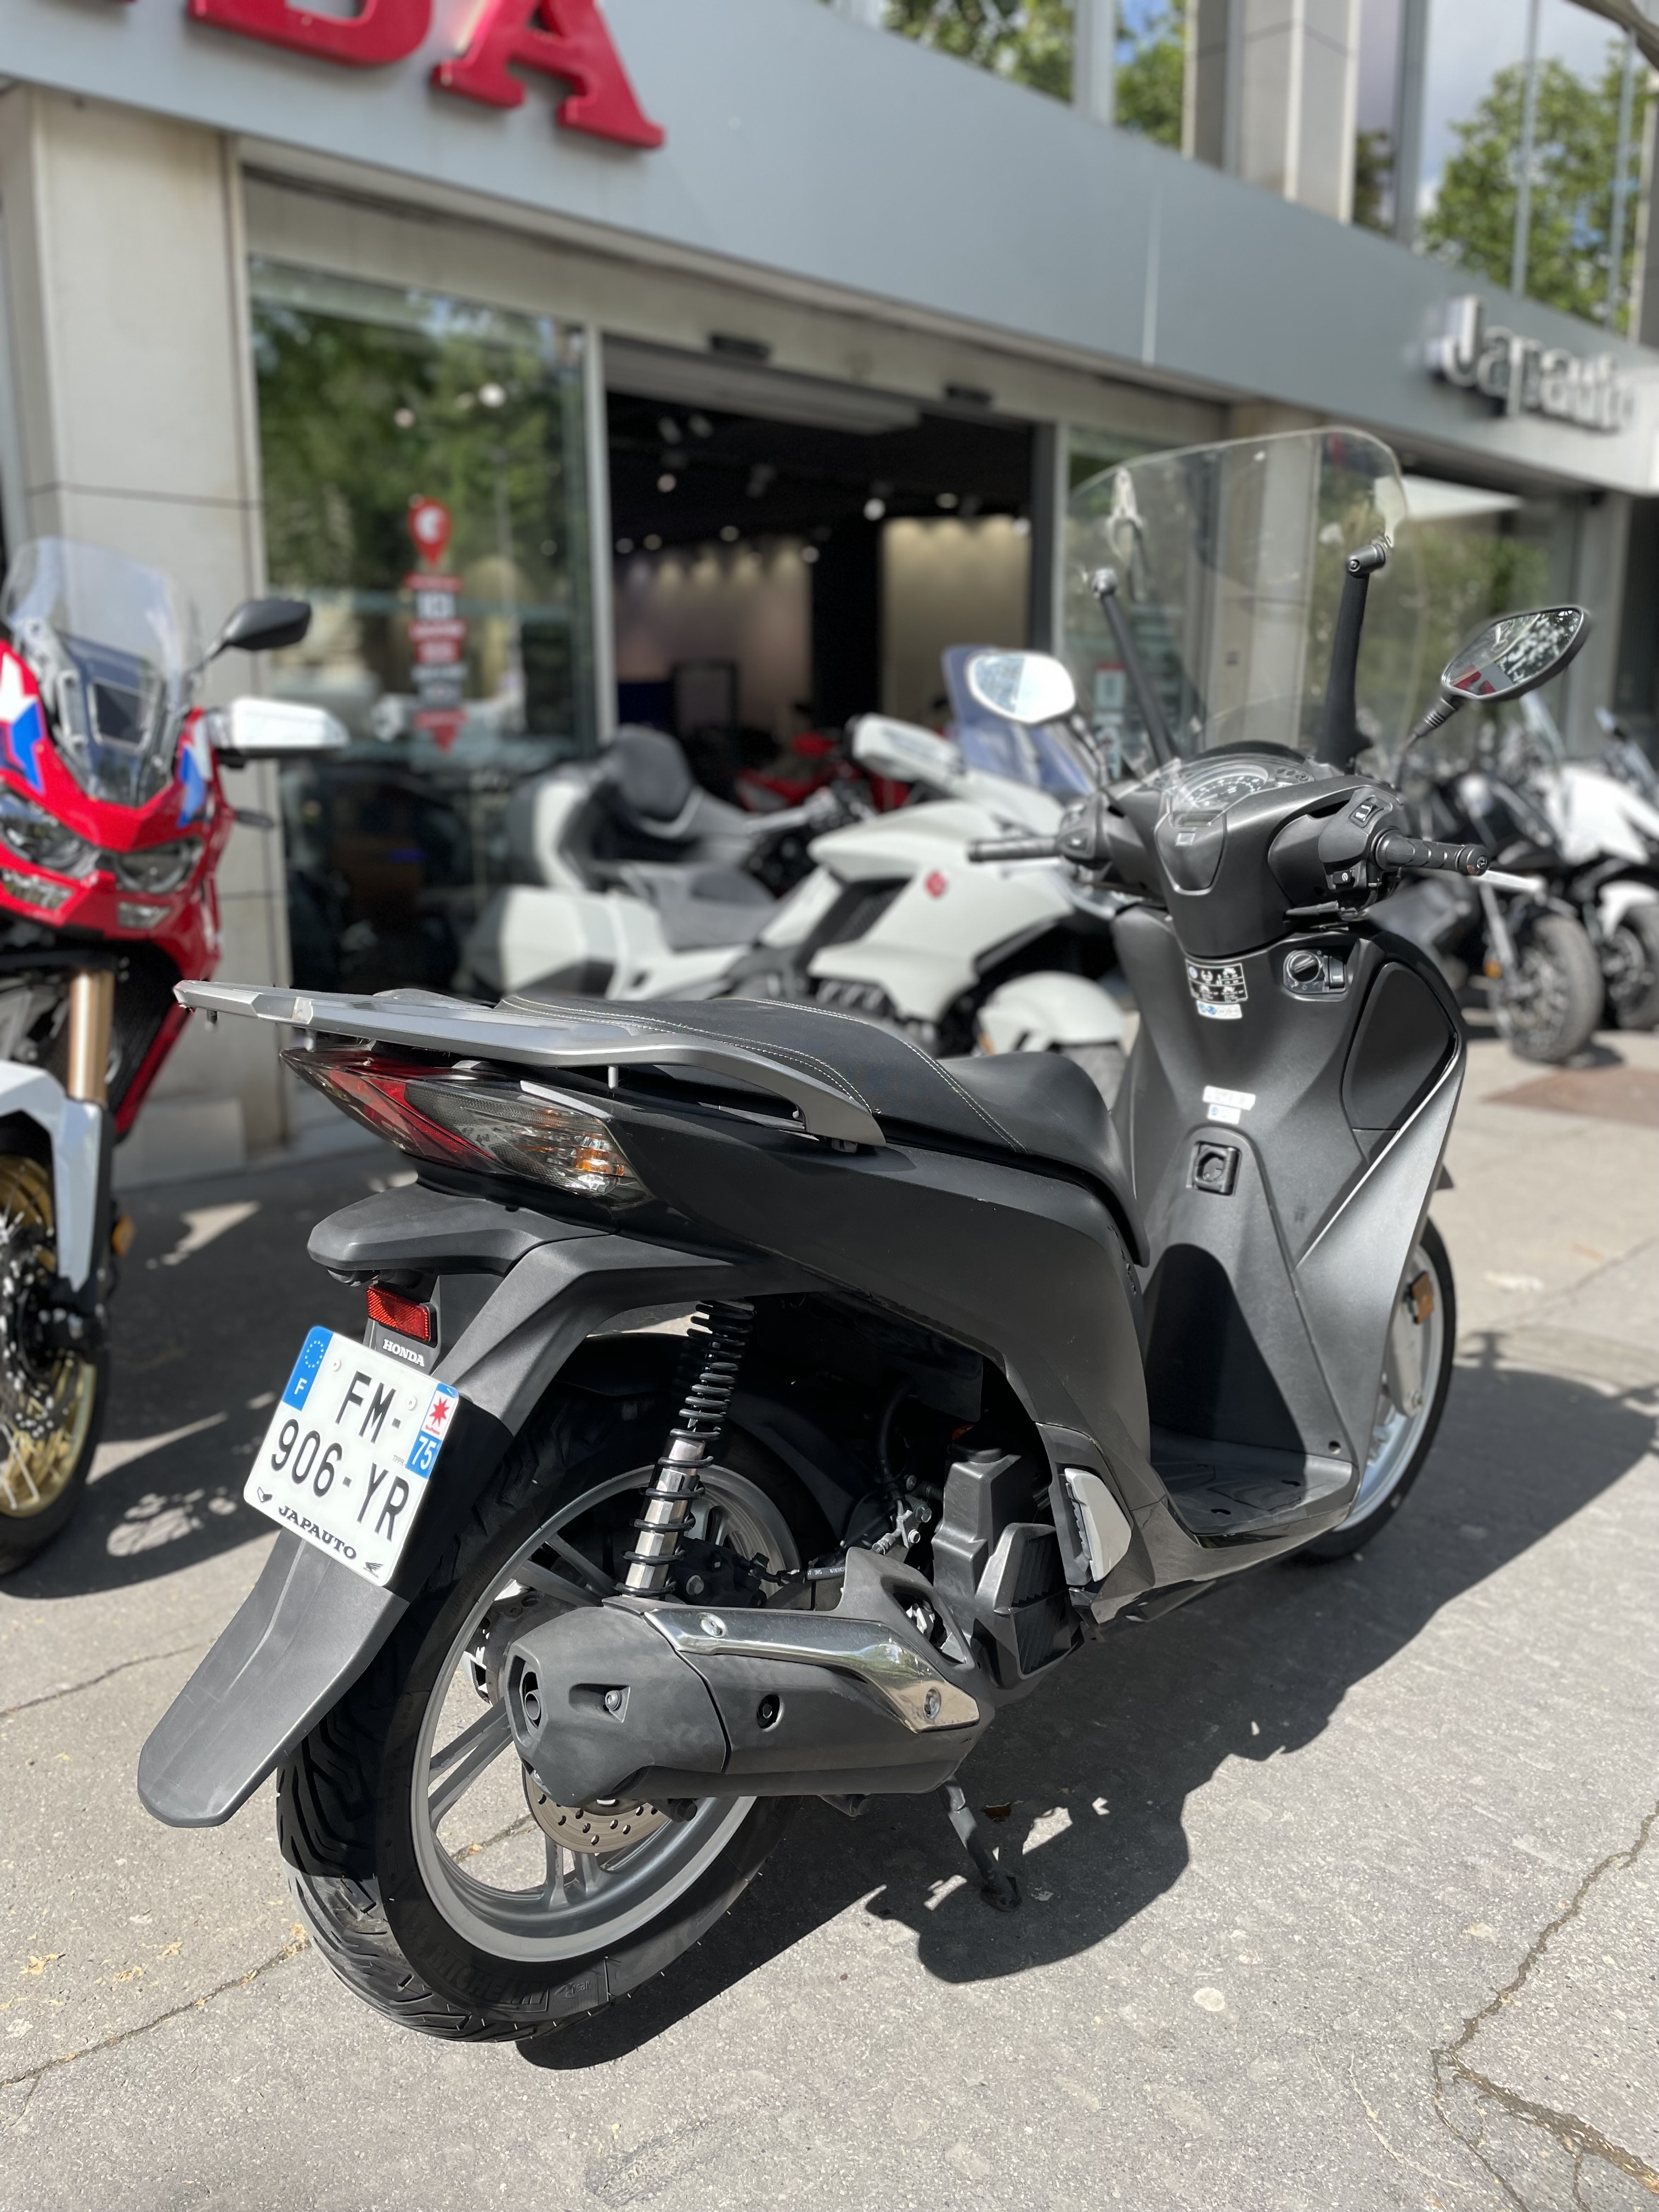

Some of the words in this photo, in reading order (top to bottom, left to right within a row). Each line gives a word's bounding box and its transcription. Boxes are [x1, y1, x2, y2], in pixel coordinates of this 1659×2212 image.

[382, 1339, 425, 1367] HONDA
[294, 1378, 307, 1395] F
[411, 1435, 437, 1470] 75
[271, 1419, 409, 1542] 906-YR
[278, 1505, 357, 1560] JAPAUTO
